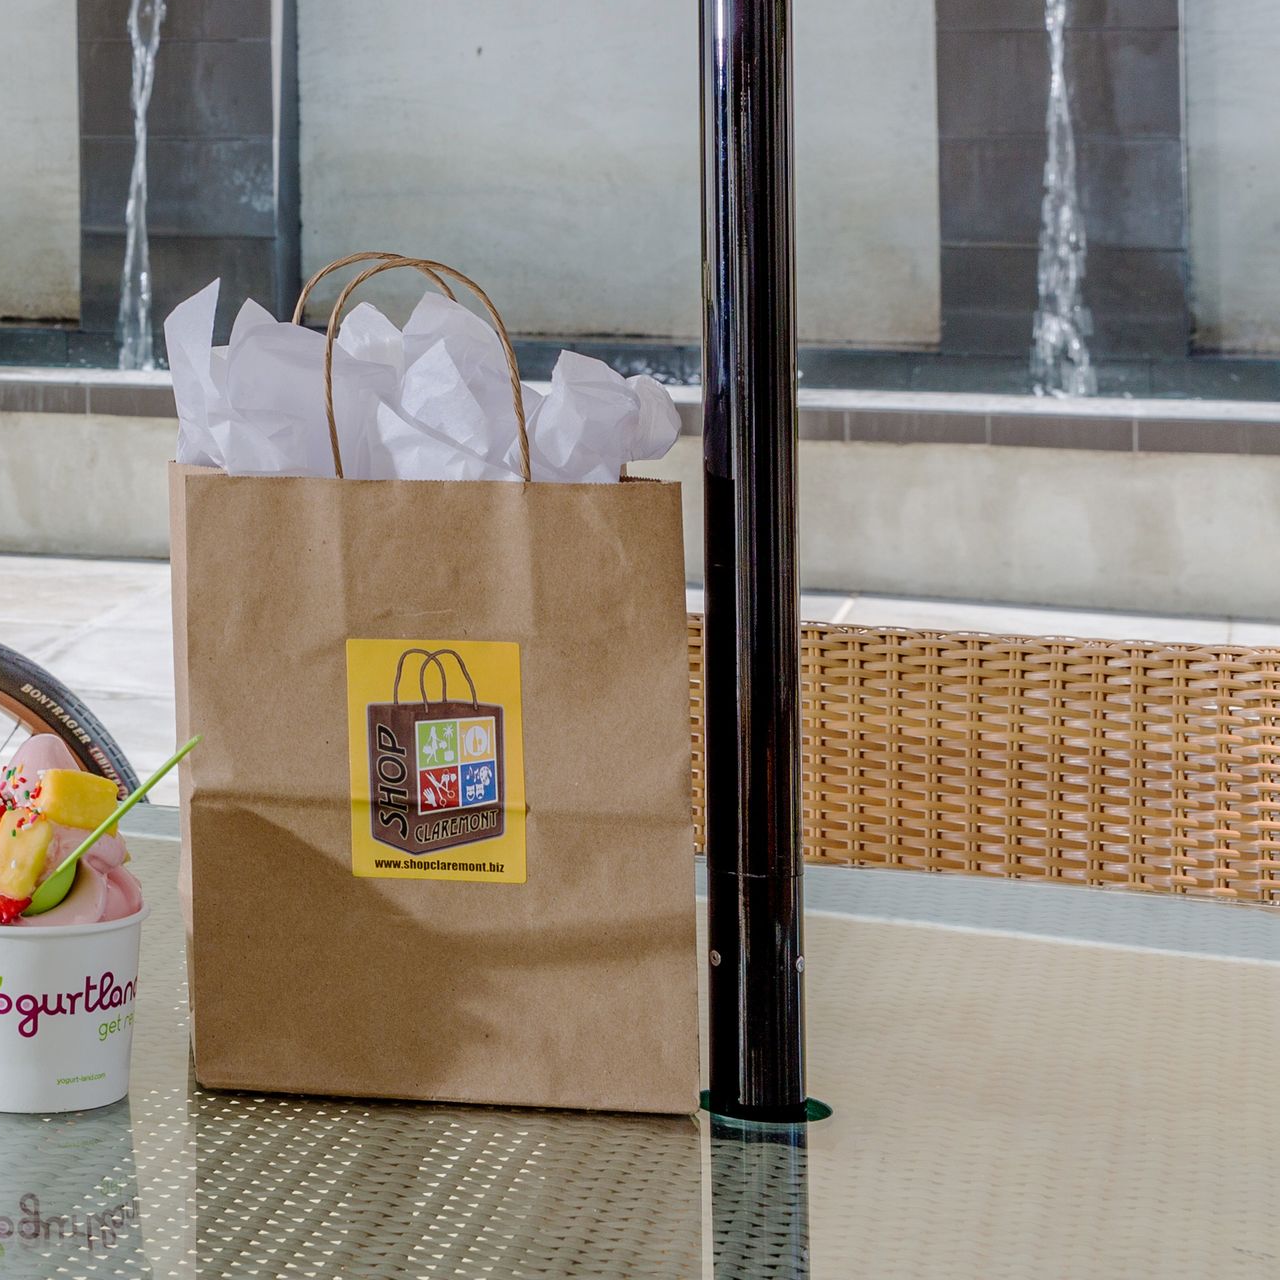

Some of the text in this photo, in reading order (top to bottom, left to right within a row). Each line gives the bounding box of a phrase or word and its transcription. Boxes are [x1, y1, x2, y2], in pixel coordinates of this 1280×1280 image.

[20, 683, 92, 745] BONTRAGER
[377, 724, 409, 840] SHOP
[415, 810, 499, 844] CLAREMONT
[374, 858, 506, 873] www.shopclaremont.biz
[99, 1013, 121, 1041] get
[55, 1071, 107, 1086] yogurt-land.com
